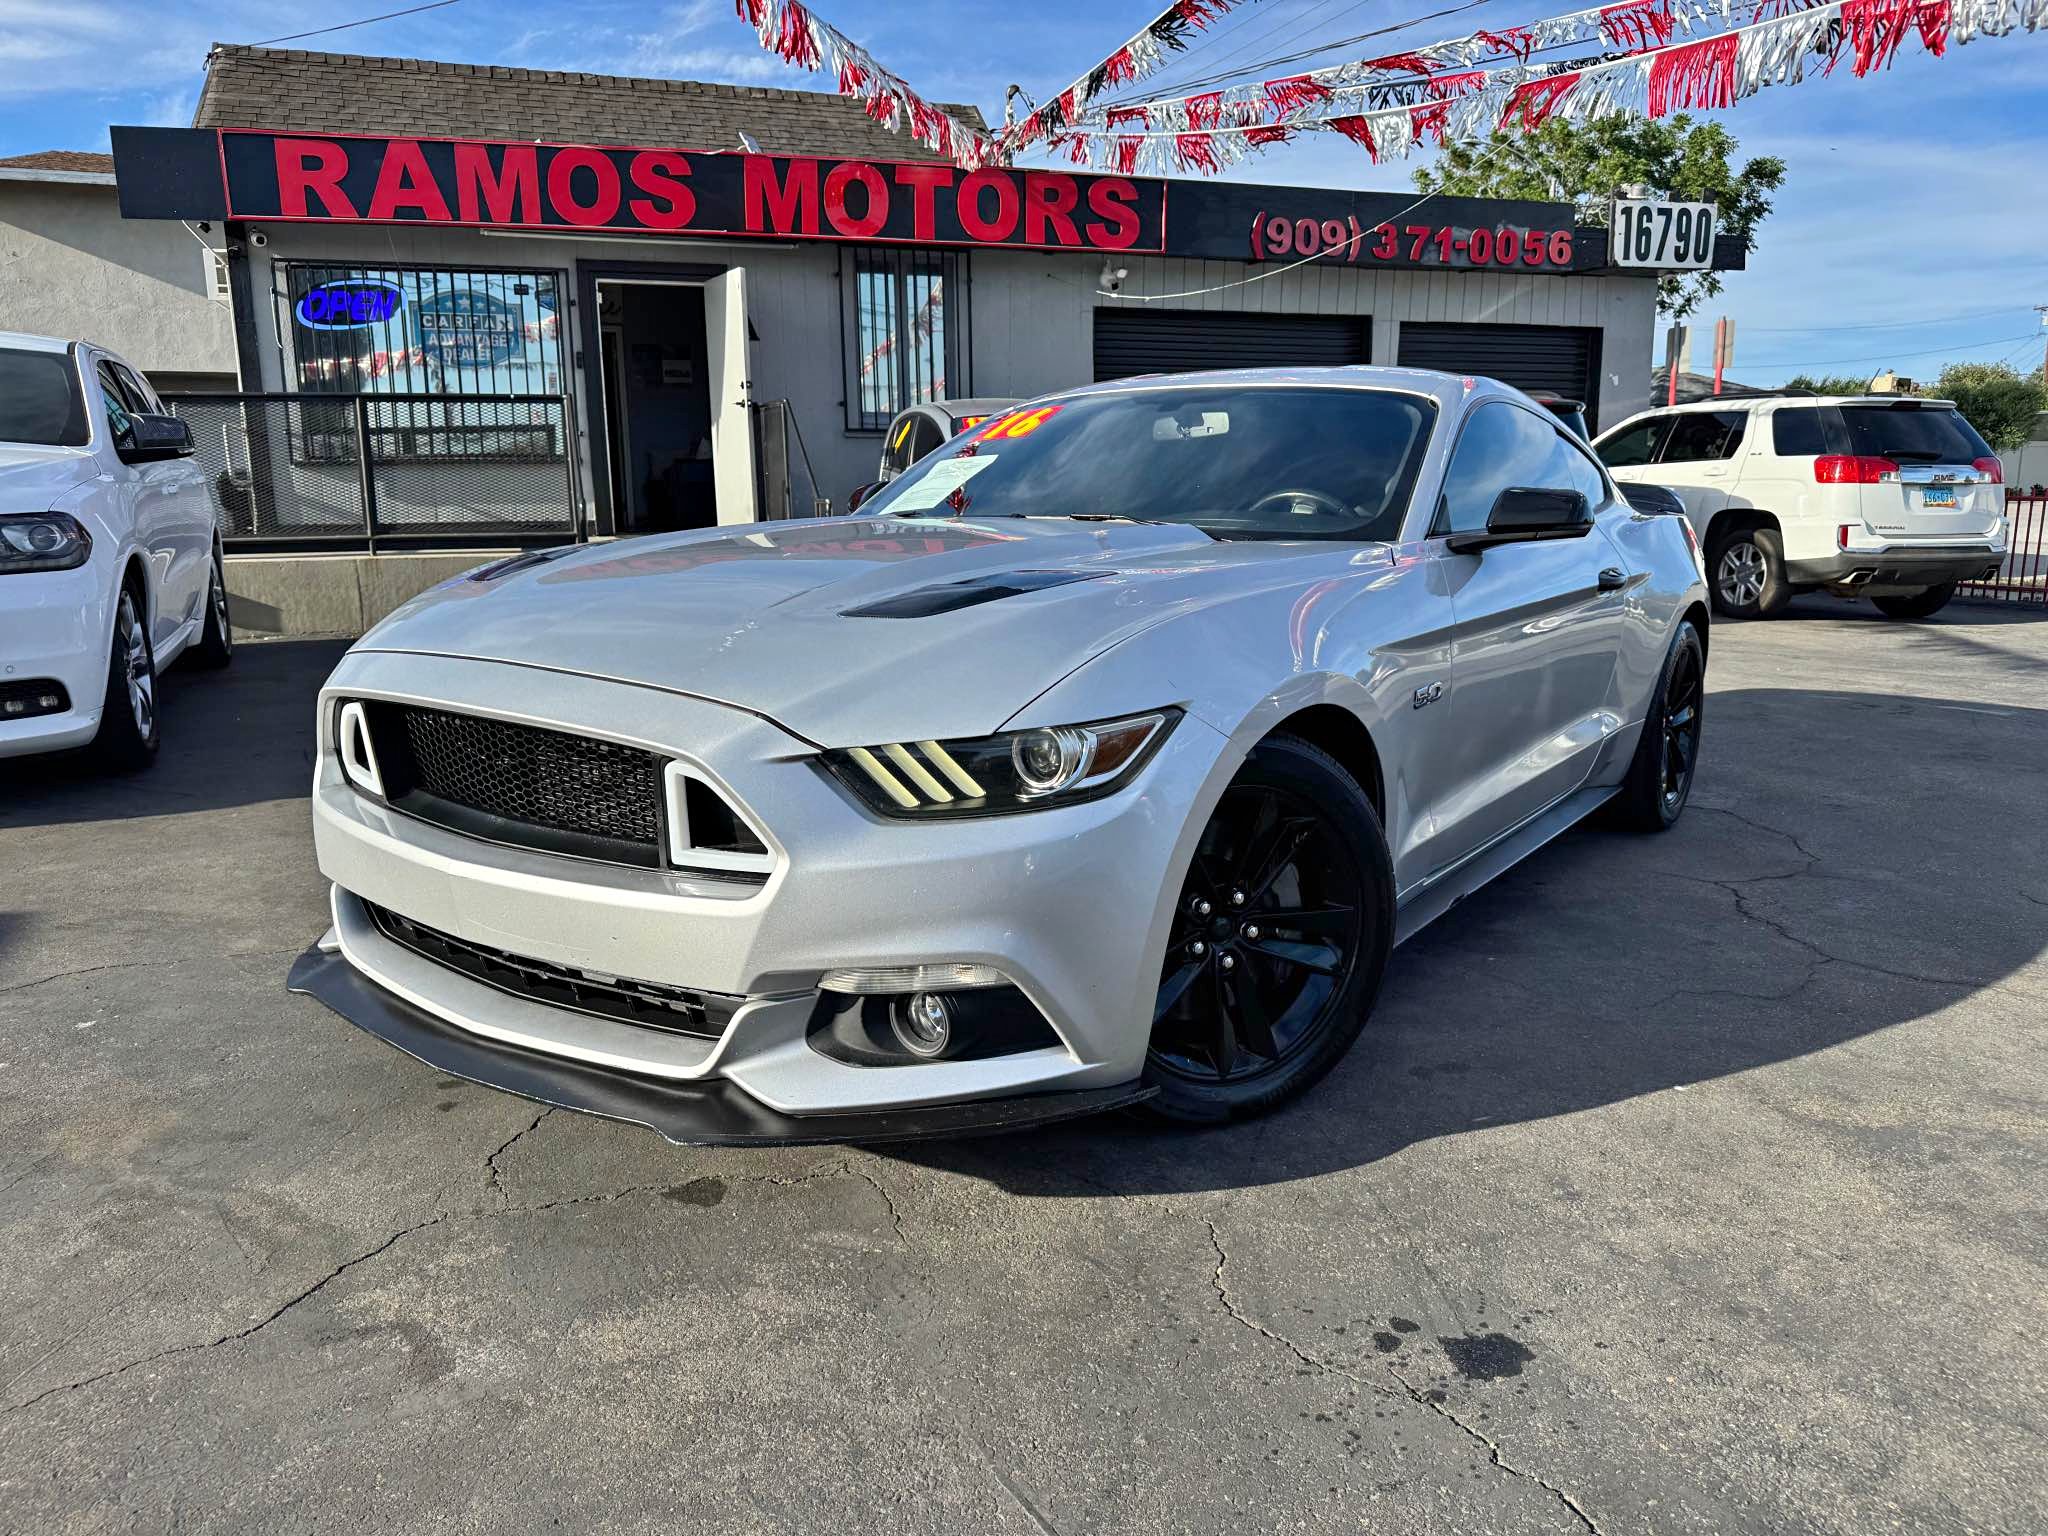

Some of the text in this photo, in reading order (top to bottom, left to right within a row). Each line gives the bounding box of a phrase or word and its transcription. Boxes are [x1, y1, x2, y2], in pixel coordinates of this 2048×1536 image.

[274, 138, 1141, 249] RAMOS MOTORS
[1250, 212, 1573, 265] (909) 371-0056
[1620, 205, 1712, 263] 16790
[302, 290, 398, 321] OPEN
[422, 314, 514, 331] CARFAX
[1413, 681, 1442, 709] 5.0
